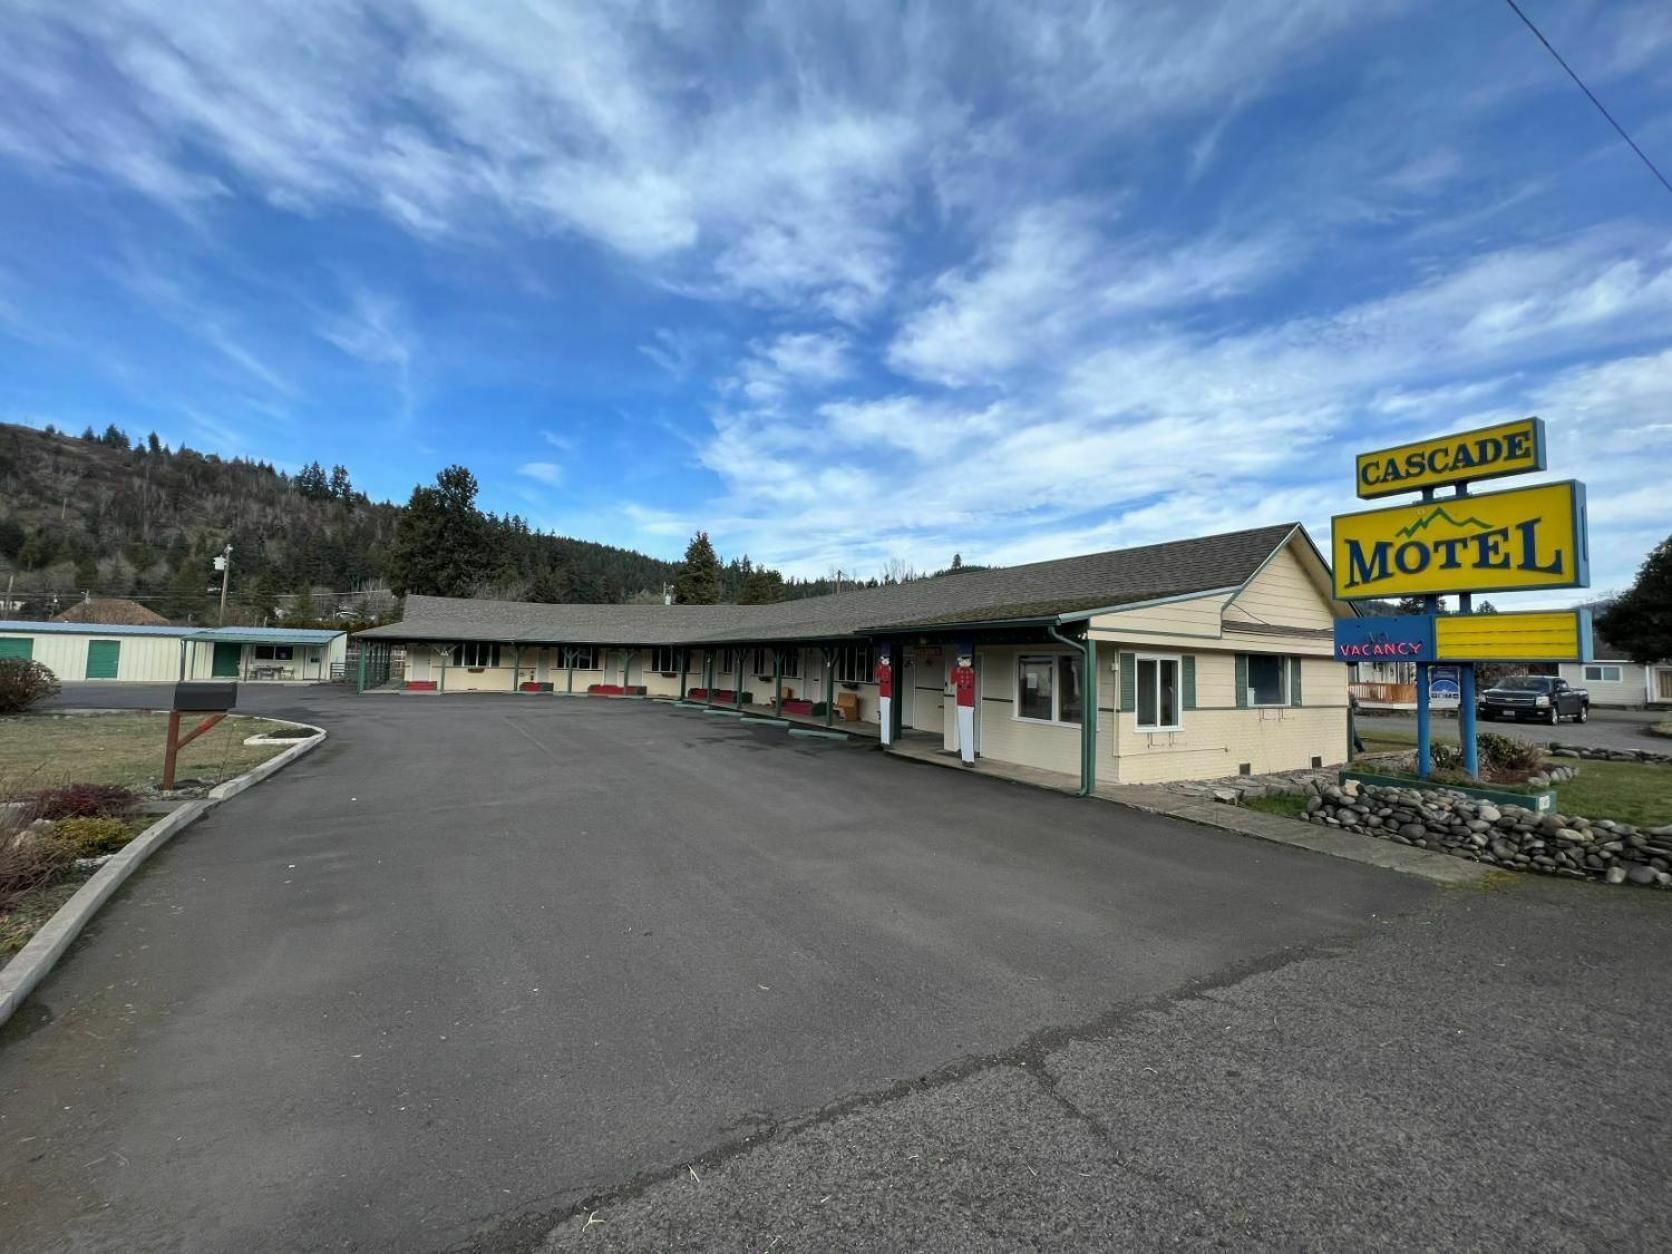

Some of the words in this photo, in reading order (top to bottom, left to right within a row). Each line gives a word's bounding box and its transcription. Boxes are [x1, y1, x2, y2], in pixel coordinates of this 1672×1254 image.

[1361, 430, 1532, 486] CASCADE
[1344, 517, 1563, 589] MOTEL
[1340, 642, 1423, 657] VACANCY
